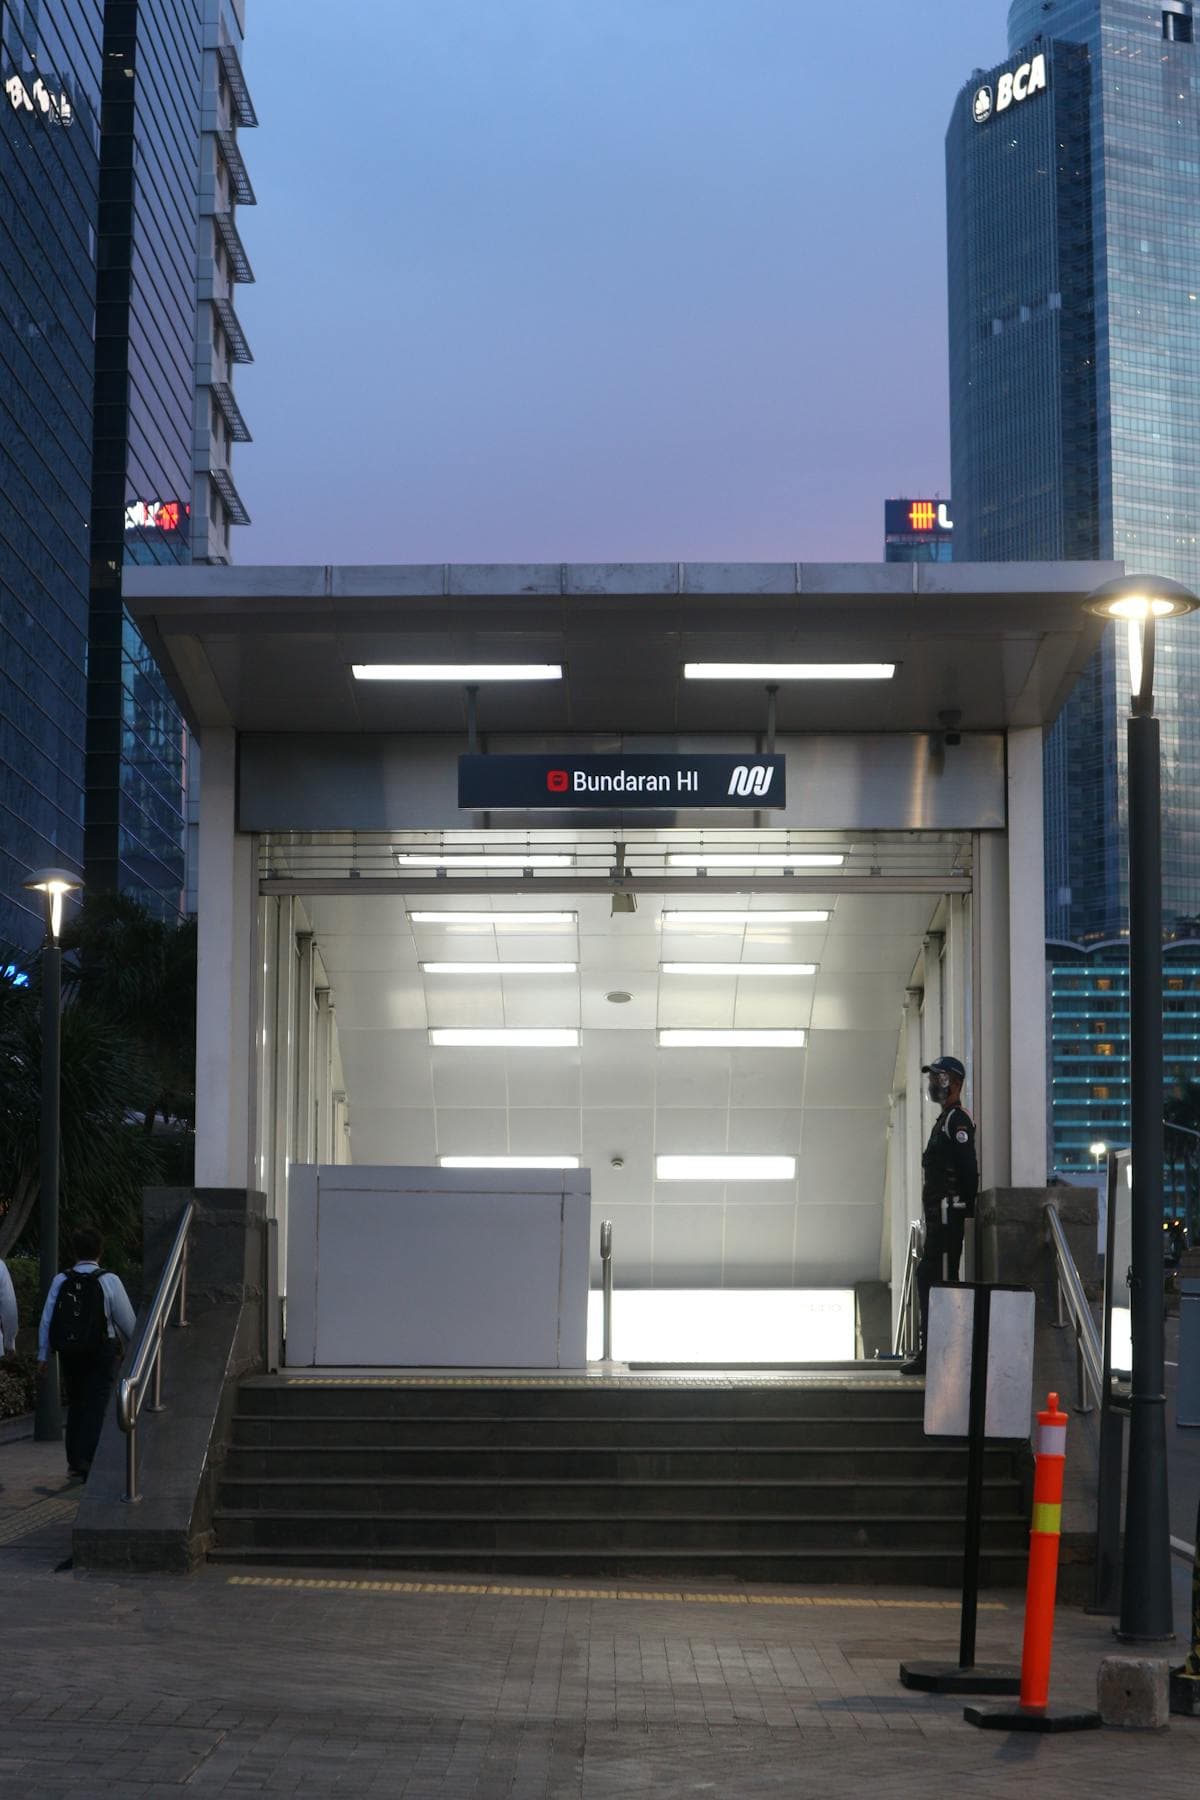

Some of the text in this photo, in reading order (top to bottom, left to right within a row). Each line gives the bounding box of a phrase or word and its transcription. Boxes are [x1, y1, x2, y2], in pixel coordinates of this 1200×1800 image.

[996, 53, 1046, 112] BCA
[573, 769, 698, 792] Bundaran HI
